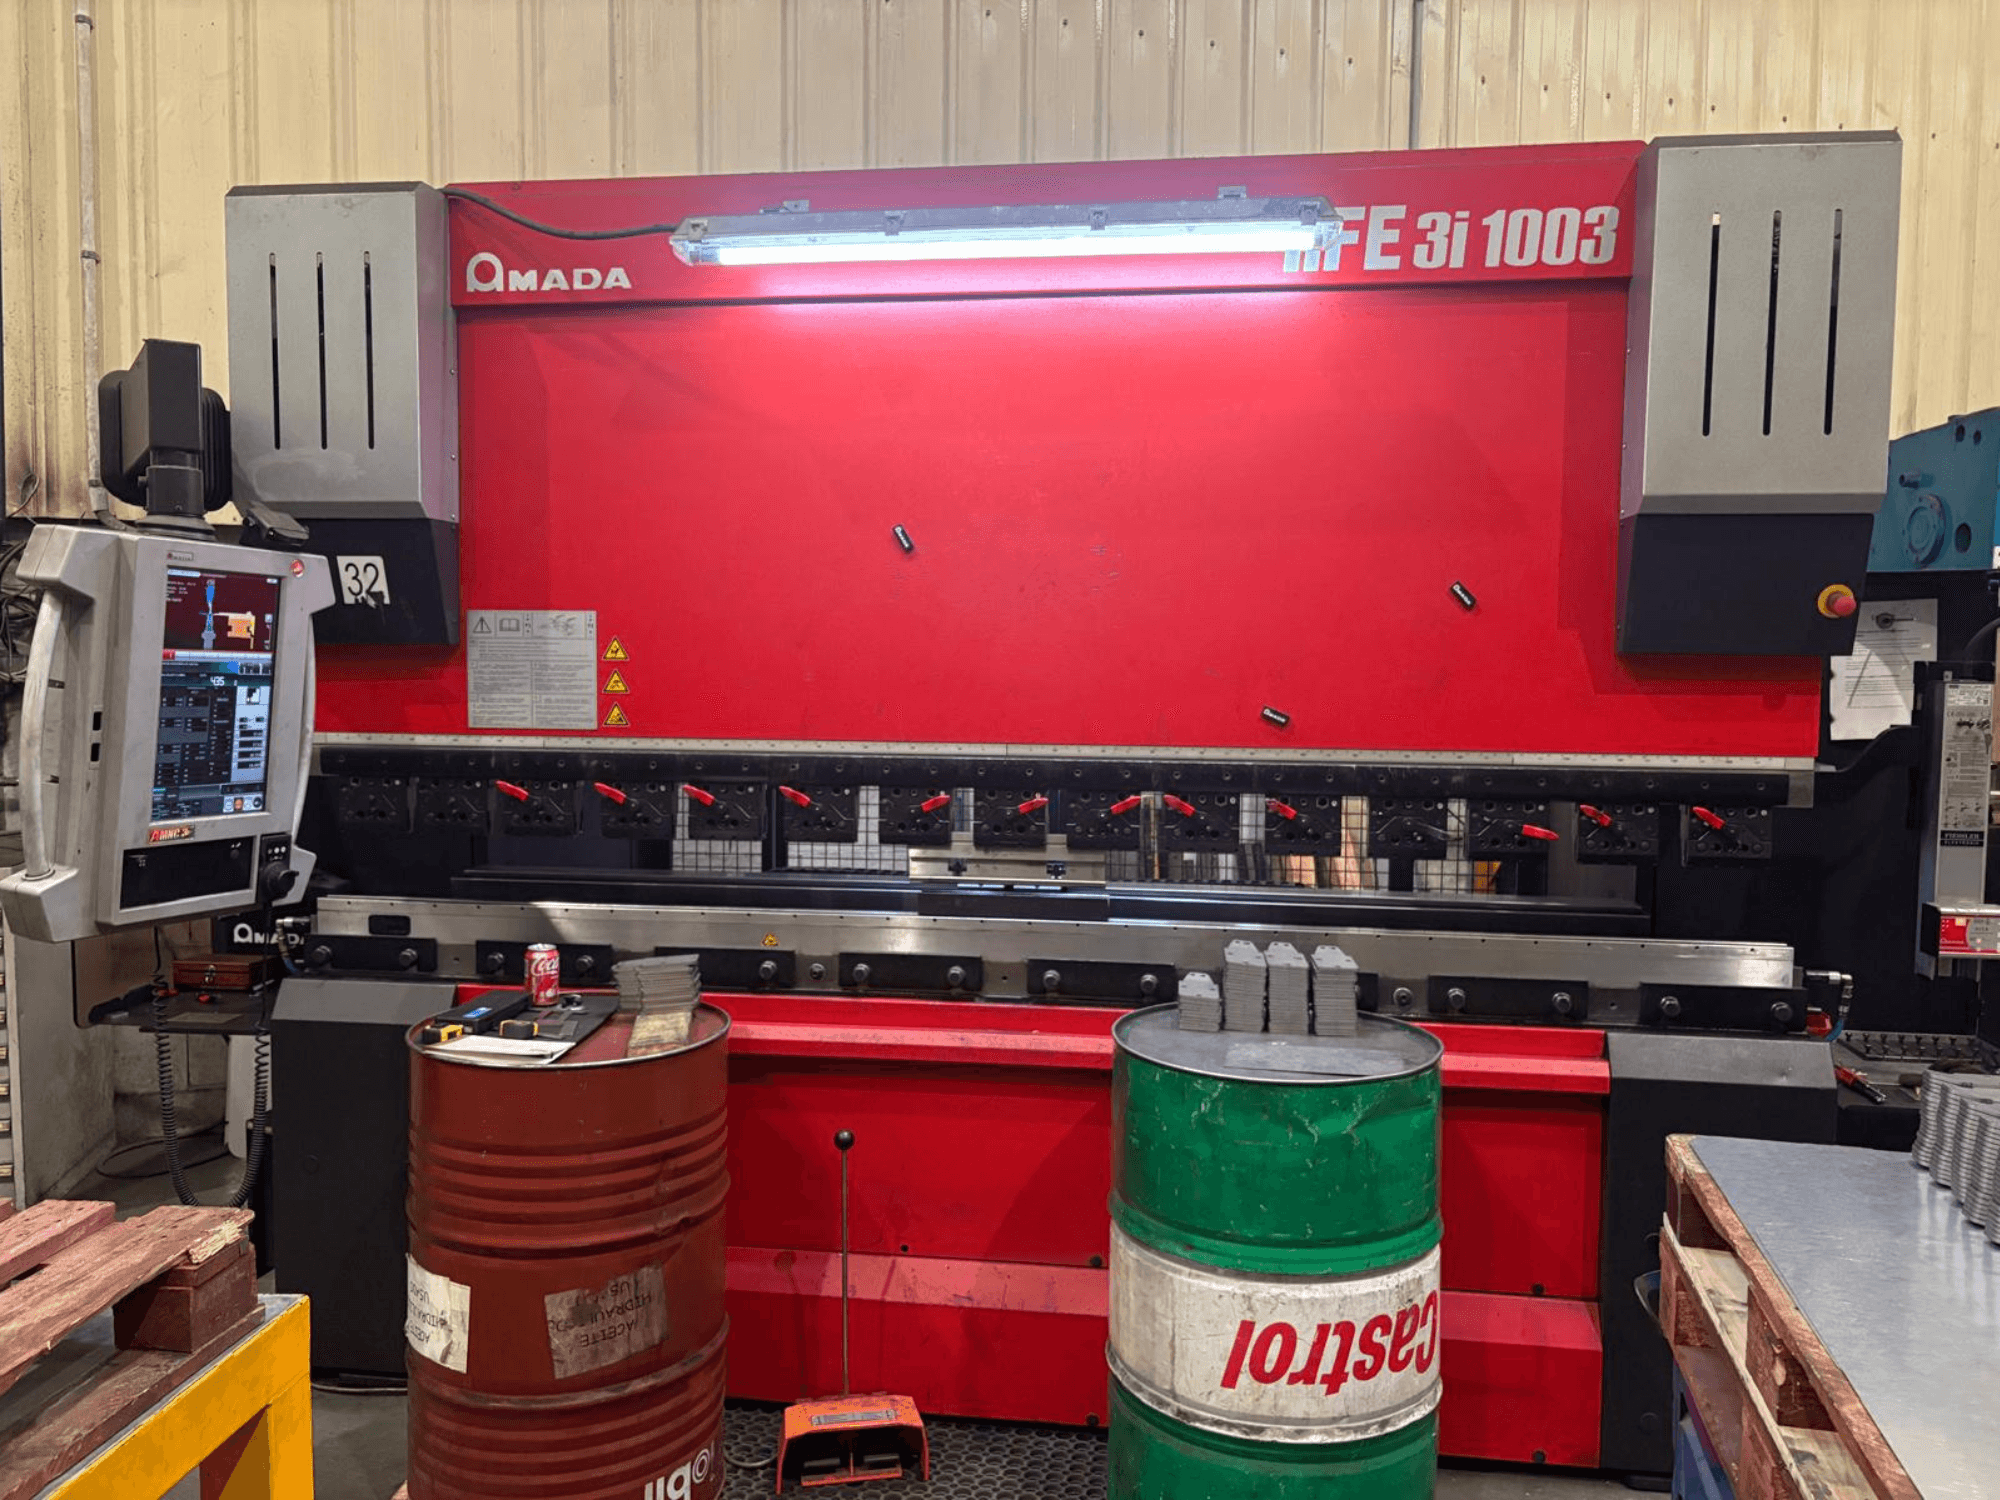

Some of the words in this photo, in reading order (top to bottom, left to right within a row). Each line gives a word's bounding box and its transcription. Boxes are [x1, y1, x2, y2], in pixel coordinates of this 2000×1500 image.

[1413, 210, 1470, 270] 3i
[1482, 206, 1620, 268] 1003
[466, 252, 632, 292] AMADA
[345, 562, 383, 596] 32
[580, 1319, 636, 1347] ACEITE
[1220, 1290, 1438, 1397] Castrol
